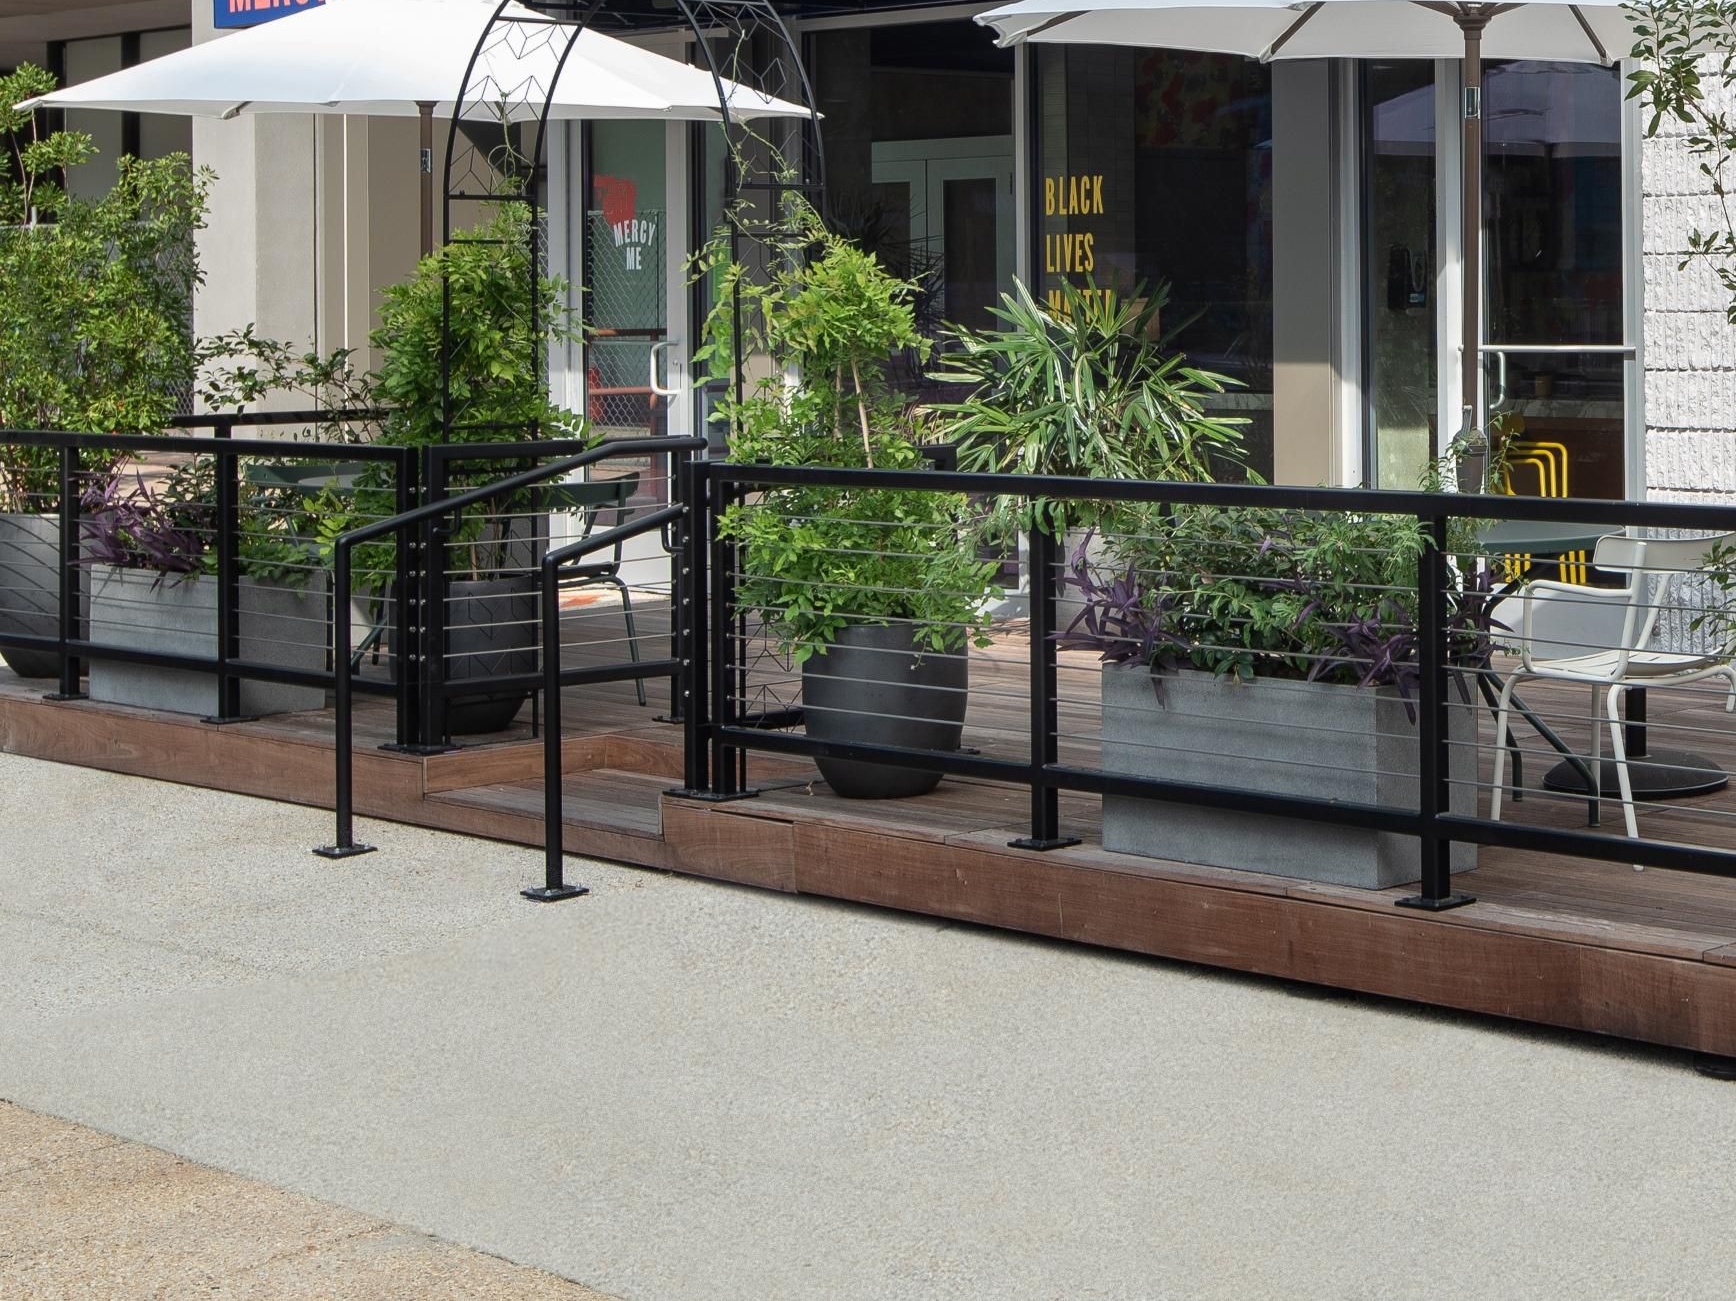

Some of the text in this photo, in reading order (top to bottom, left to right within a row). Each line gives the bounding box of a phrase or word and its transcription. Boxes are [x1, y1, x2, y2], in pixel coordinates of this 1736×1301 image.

[1045, 175, 1104, 216] BLACK
[613, 219, 656, 247] MERCY
[626, 247, 642, 270] ME
[1046, 233, 1094, 273] LIVES
